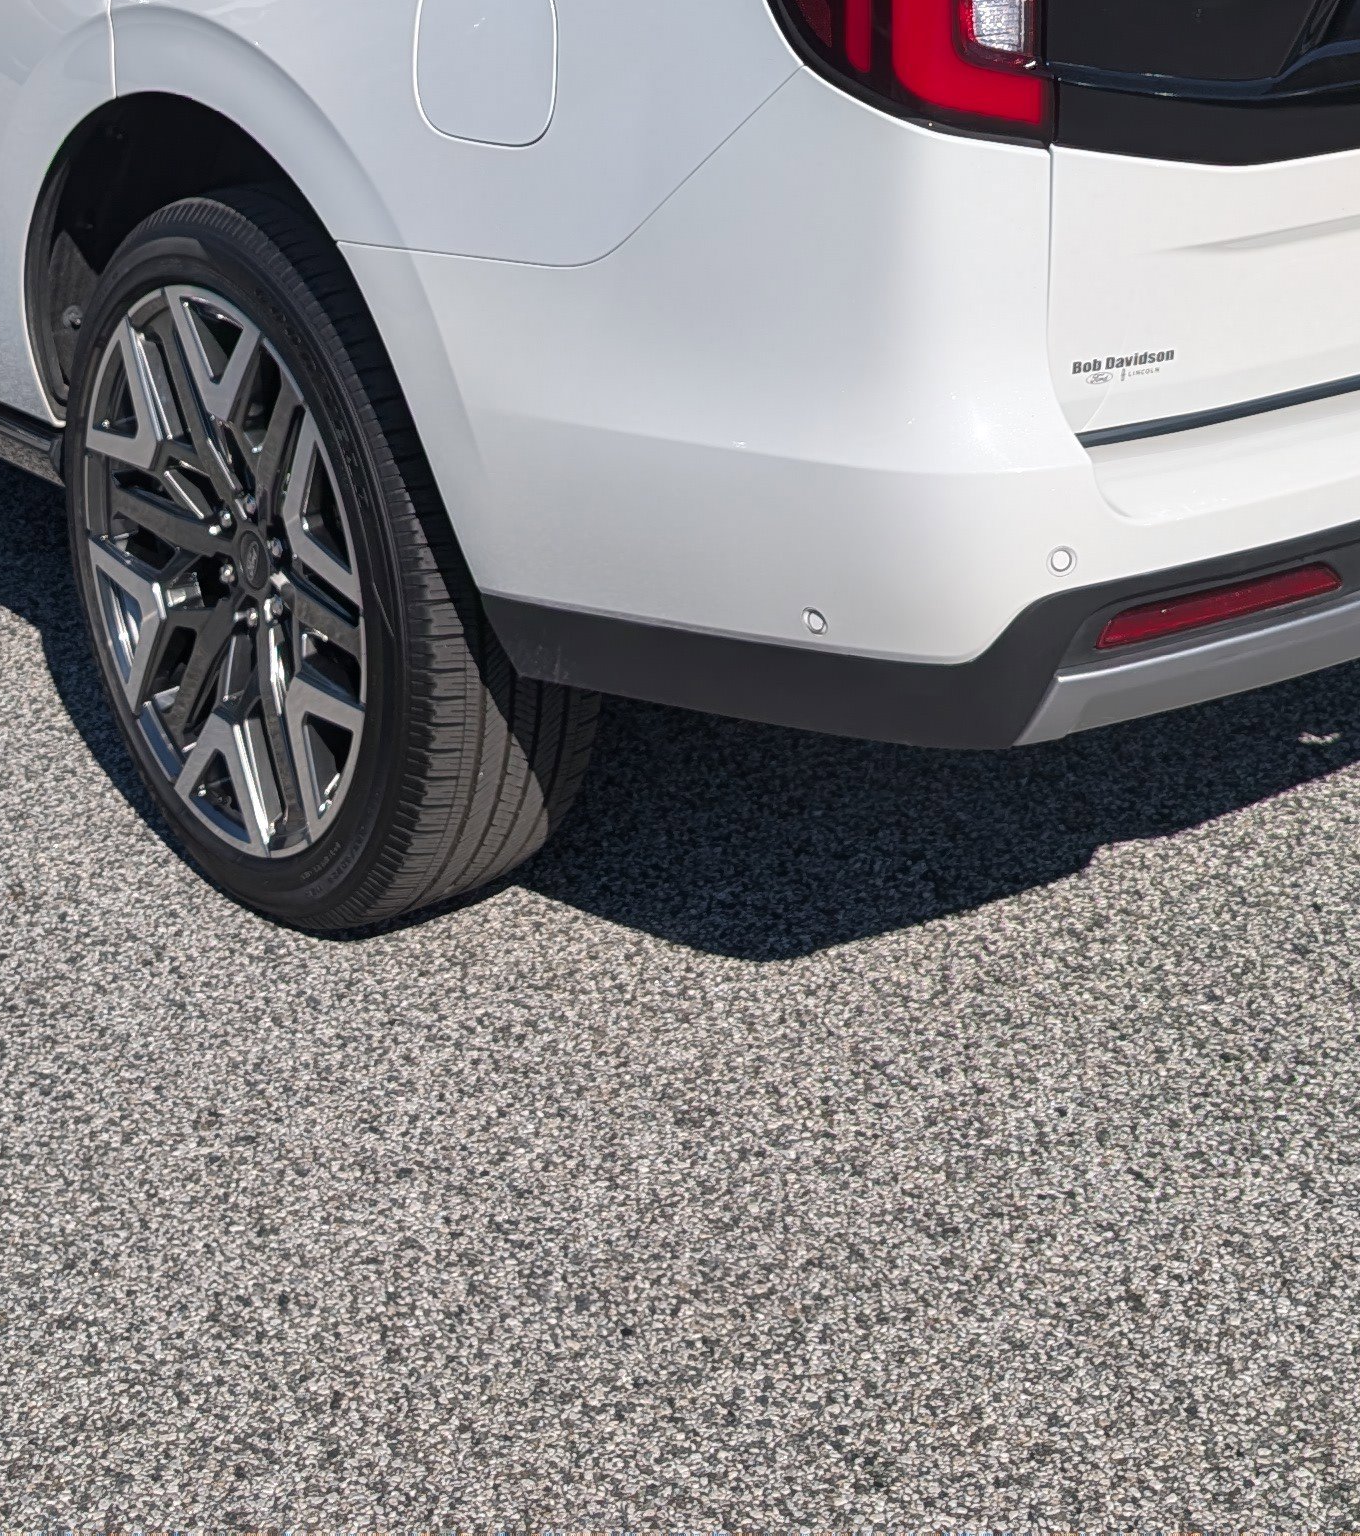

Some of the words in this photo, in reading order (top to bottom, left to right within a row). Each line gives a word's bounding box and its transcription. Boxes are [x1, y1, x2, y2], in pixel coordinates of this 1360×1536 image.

[1071, 359, 1102, 375] Bob
[1105, 349, 1175, 370] Davidson
[1128, 367, 1160, 377] LINCOLN
